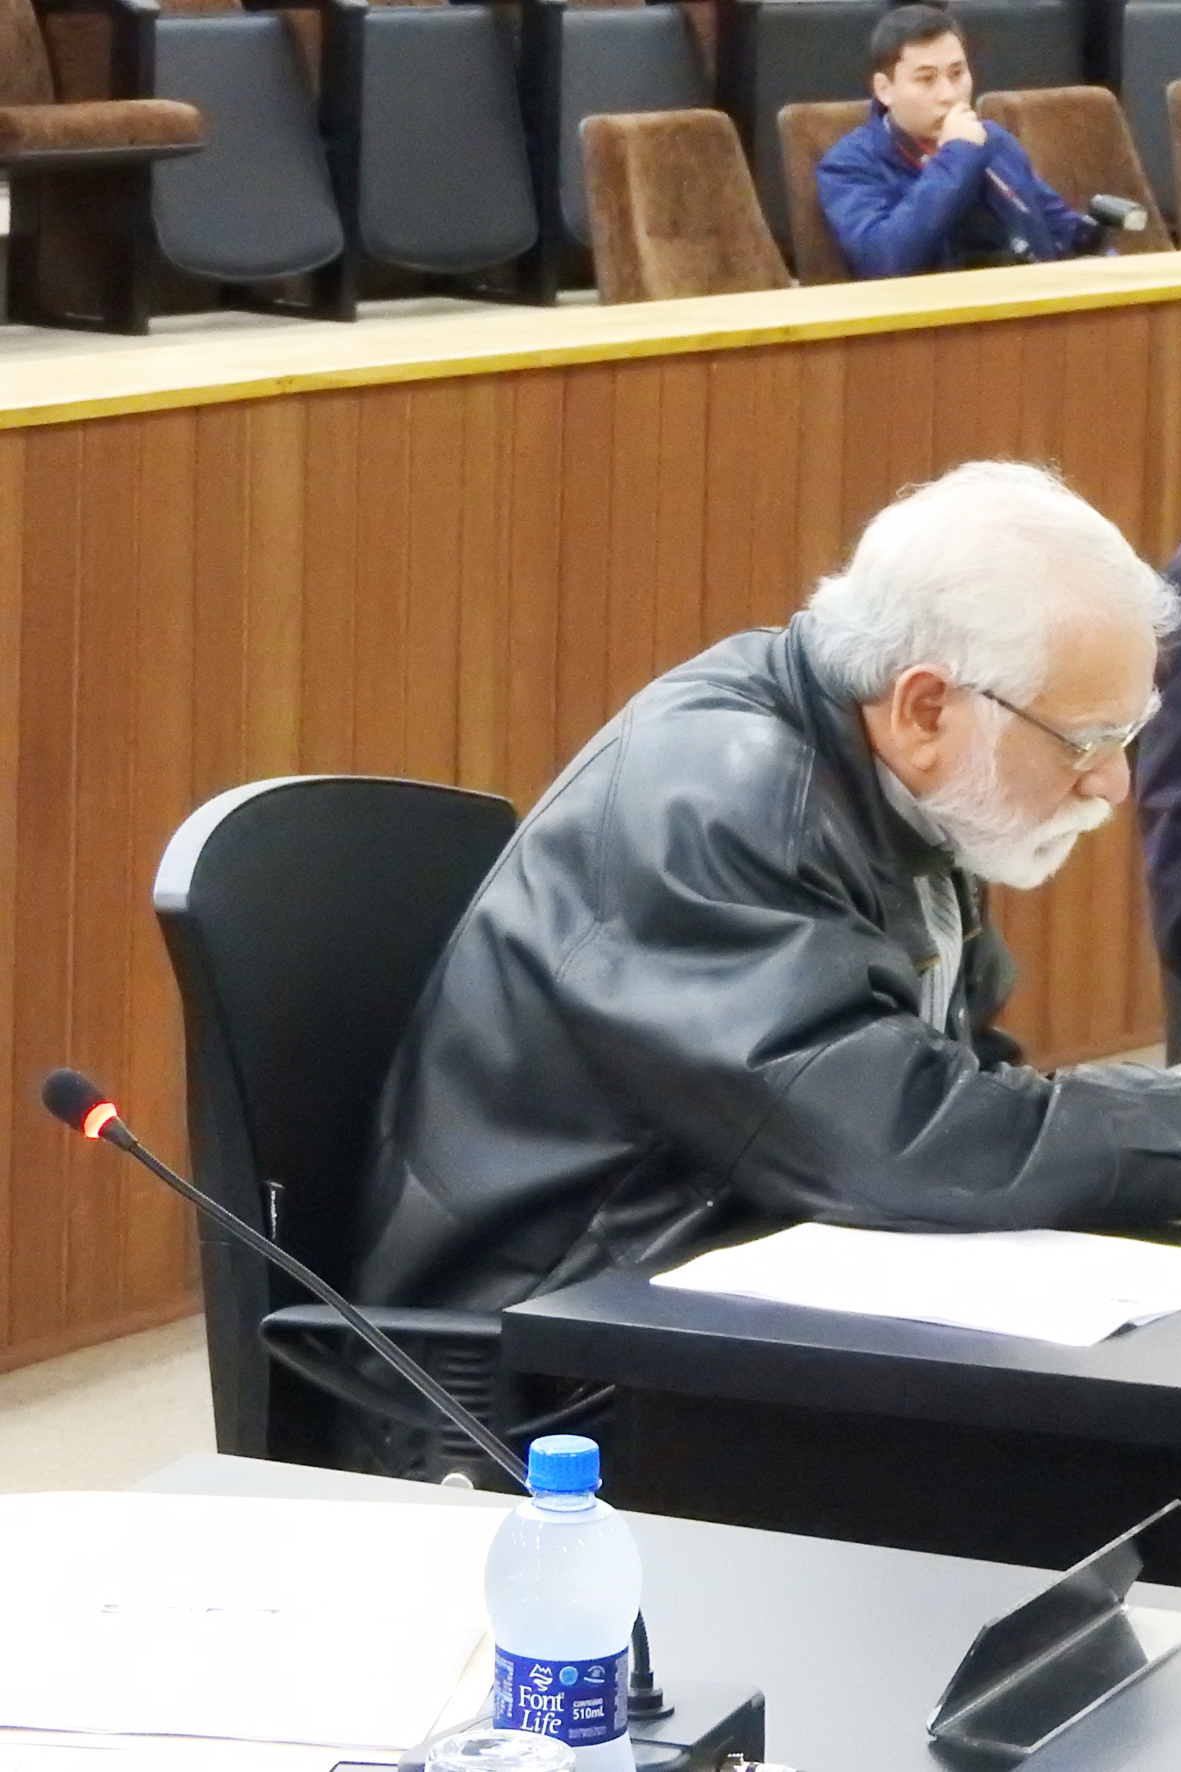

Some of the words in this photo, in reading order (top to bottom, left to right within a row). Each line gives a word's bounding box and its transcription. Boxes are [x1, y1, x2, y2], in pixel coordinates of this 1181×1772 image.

[518, 1685, 565, 1712] Font
[520, 1709, 562, 1735] Life
[572, 1706, 605, 1720] 510mL
